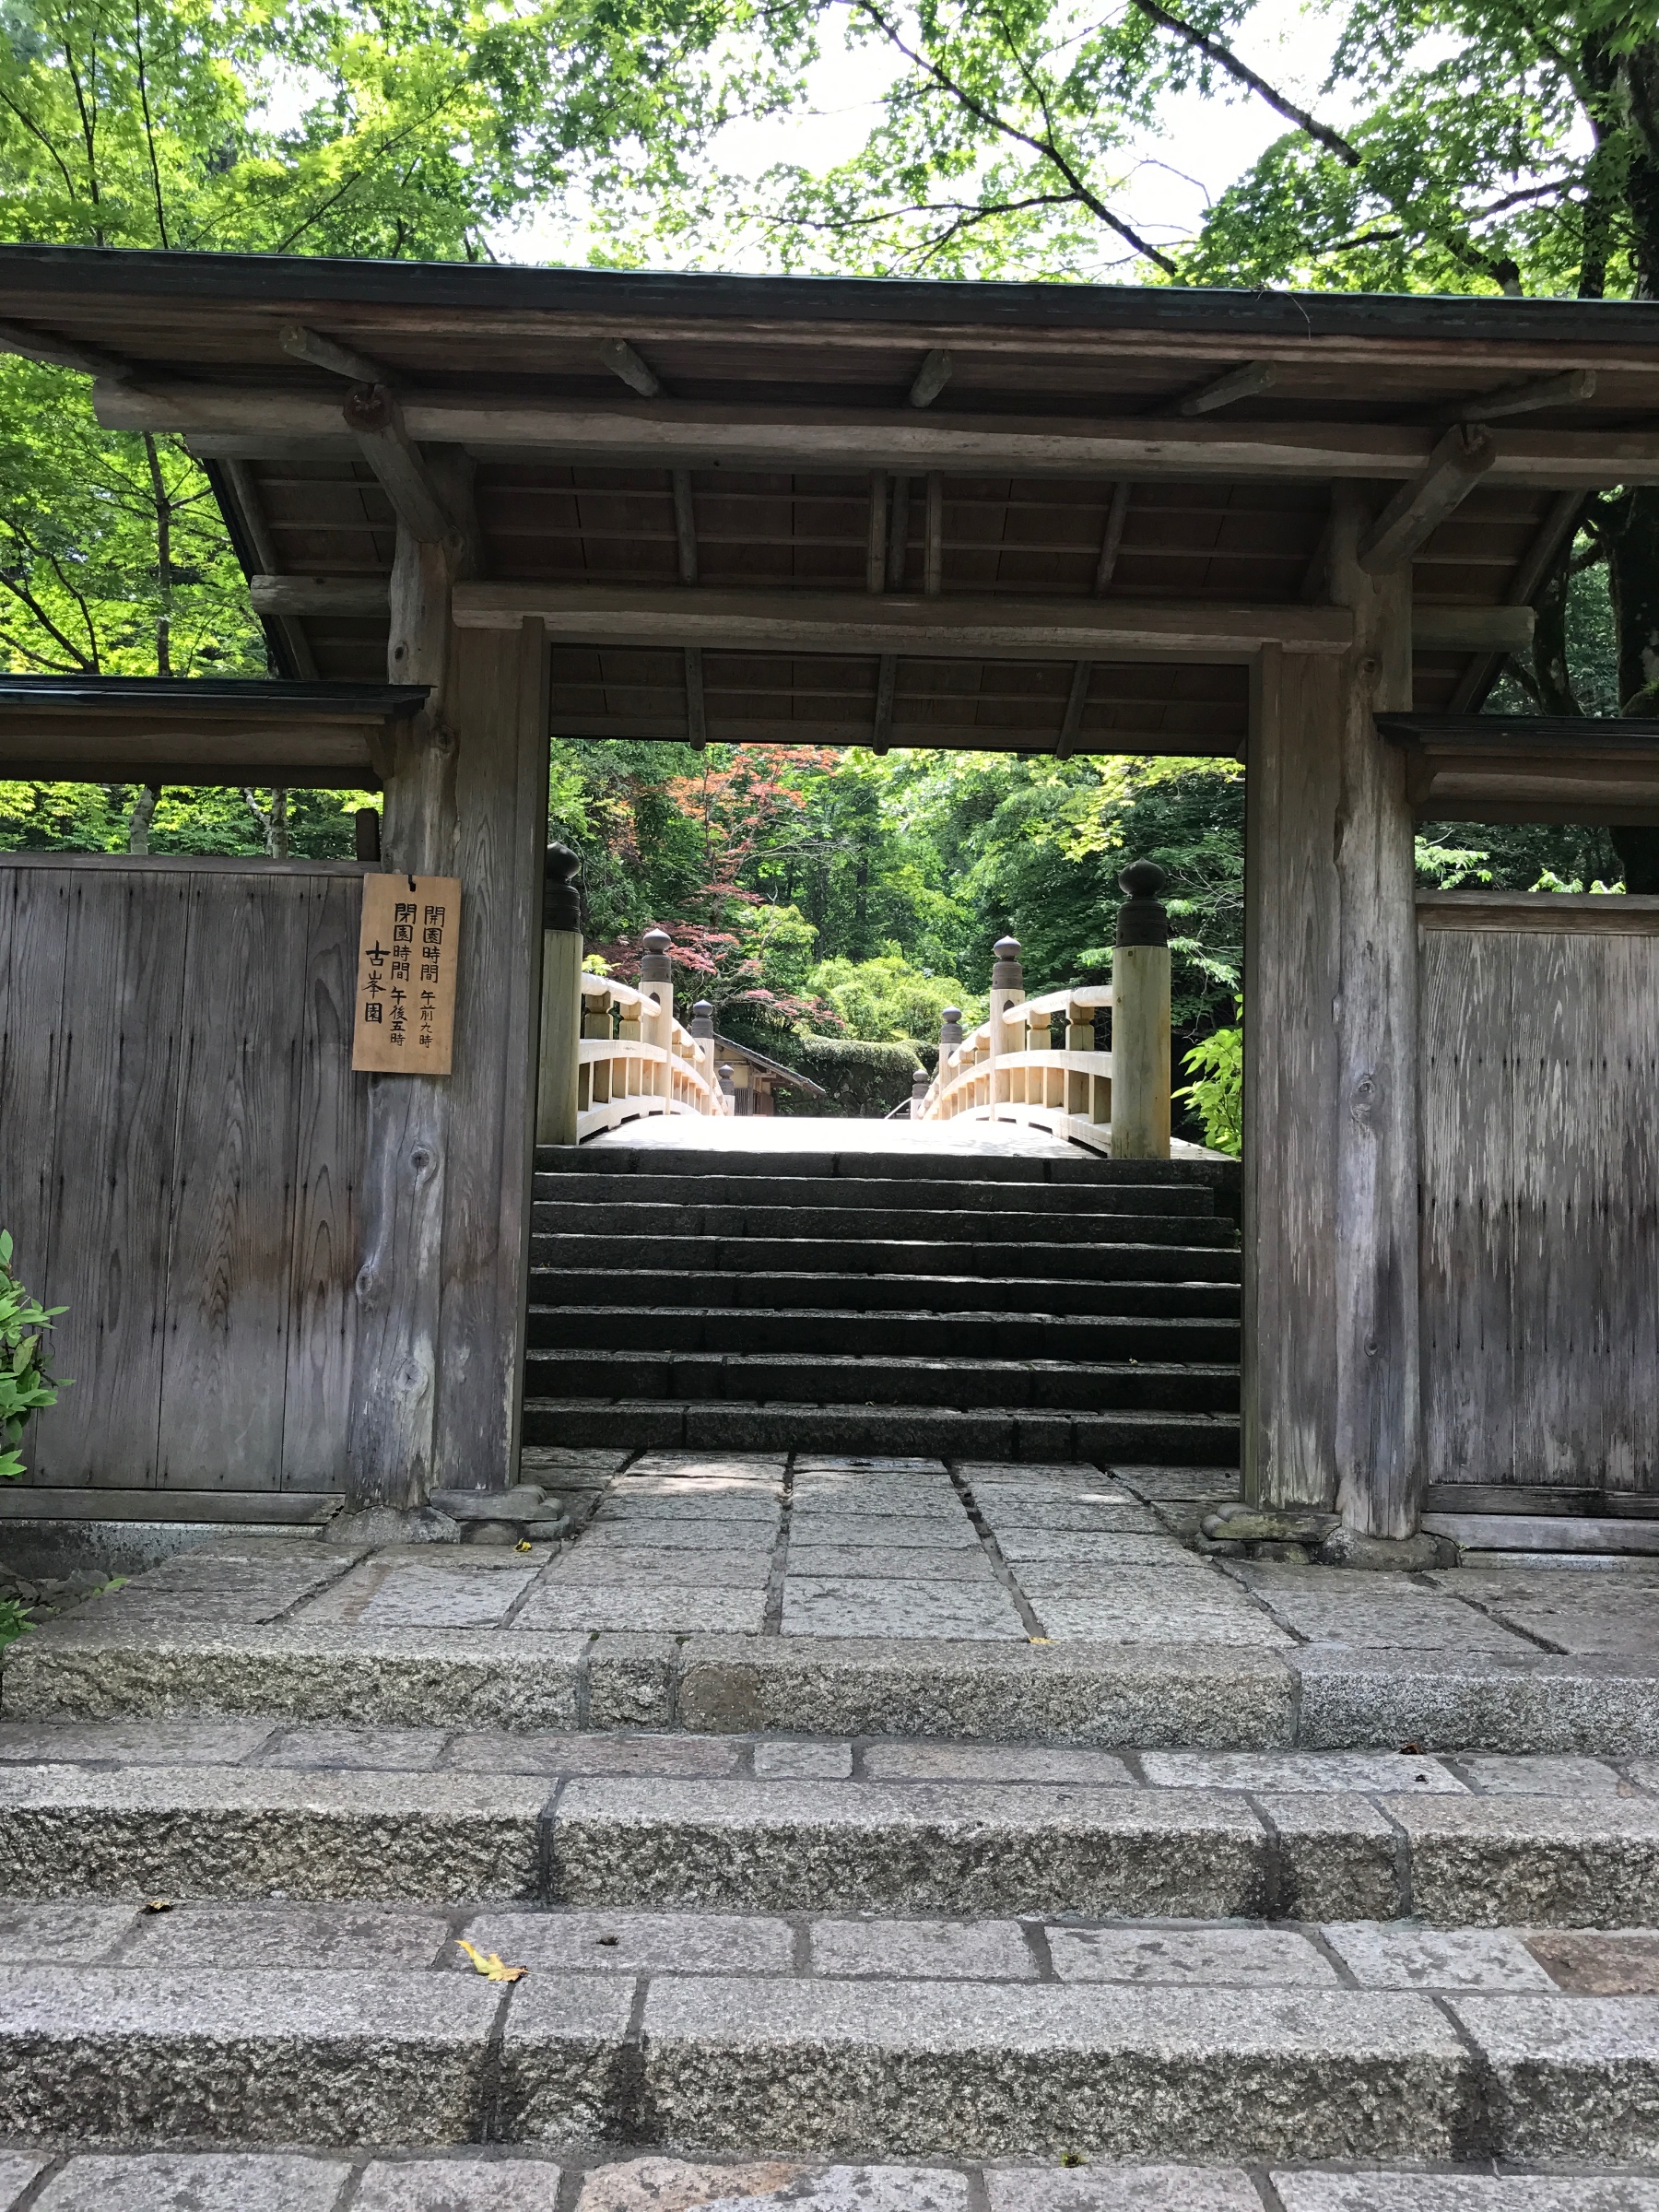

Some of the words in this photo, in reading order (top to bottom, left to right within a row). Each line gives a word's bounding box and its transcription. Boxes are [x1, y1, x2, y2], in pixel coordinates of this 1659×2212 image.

[391, 903, 417, 982] 閉園時間
[420, 905, 445, 983] 開園時間
[389, 986, 407, 1046] 午後五時
[419, 990, 436, 1048] 午前九時
